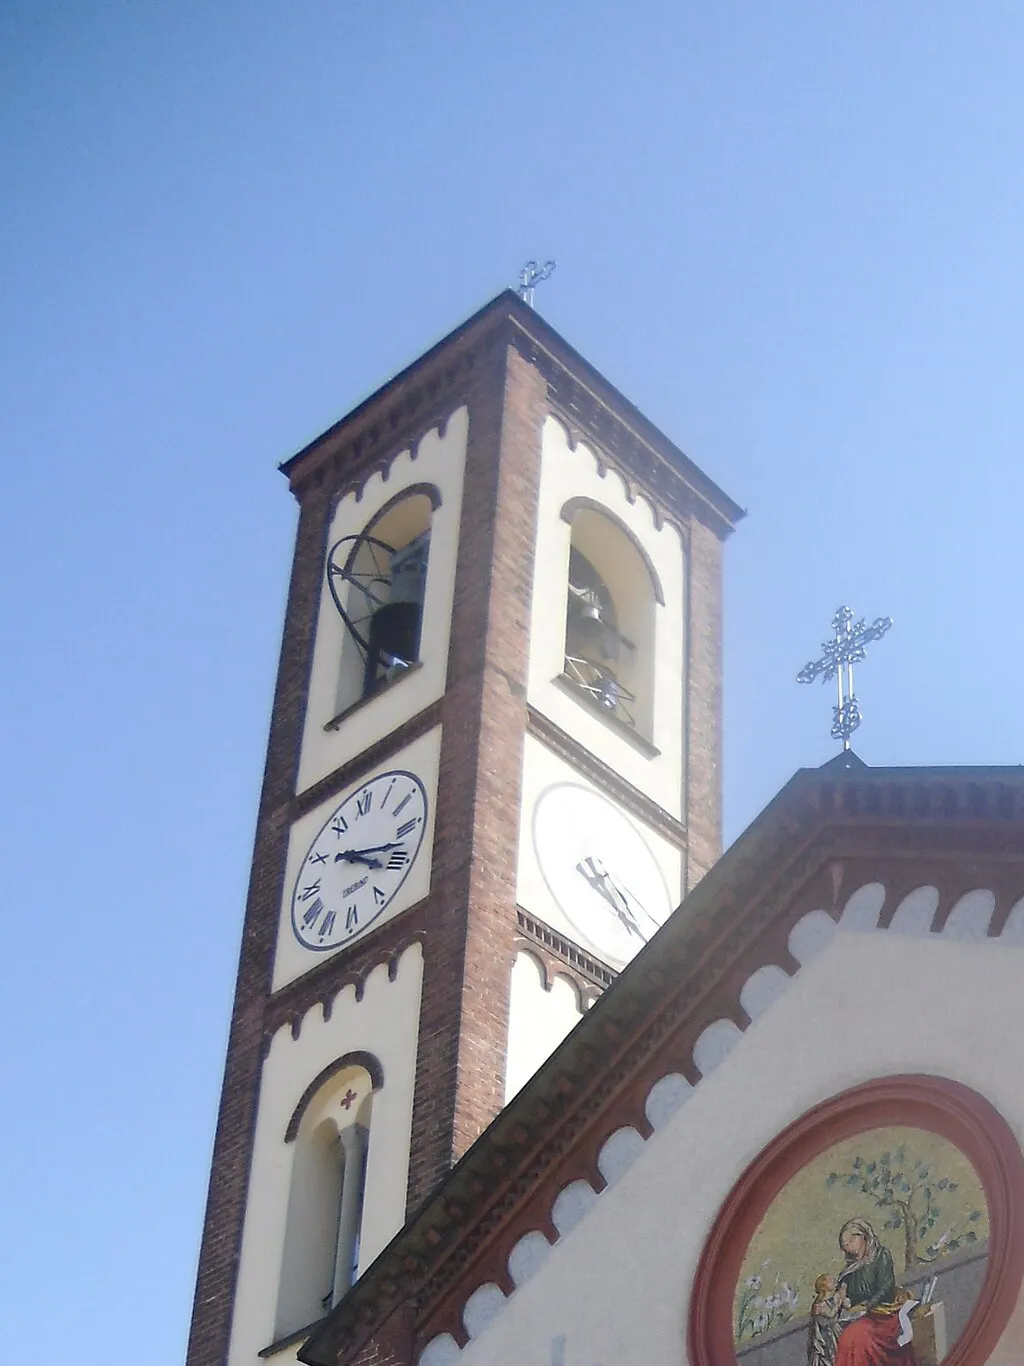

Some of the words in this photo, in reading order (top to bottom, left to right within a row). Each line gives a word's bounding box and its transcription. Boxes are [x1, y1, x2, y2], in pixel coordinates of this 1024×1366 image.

[355, 791, 373, 821] XII
[331, 816, 349, 840] XI
[396, 817, 417, 840] III
[311, 852, 330, 864] X
[386, 851, 408, 870] IIII
[302, 878, 321, 901] IX
[373, 886, 385, 904] V
[346, 904, 358, 930] VI
